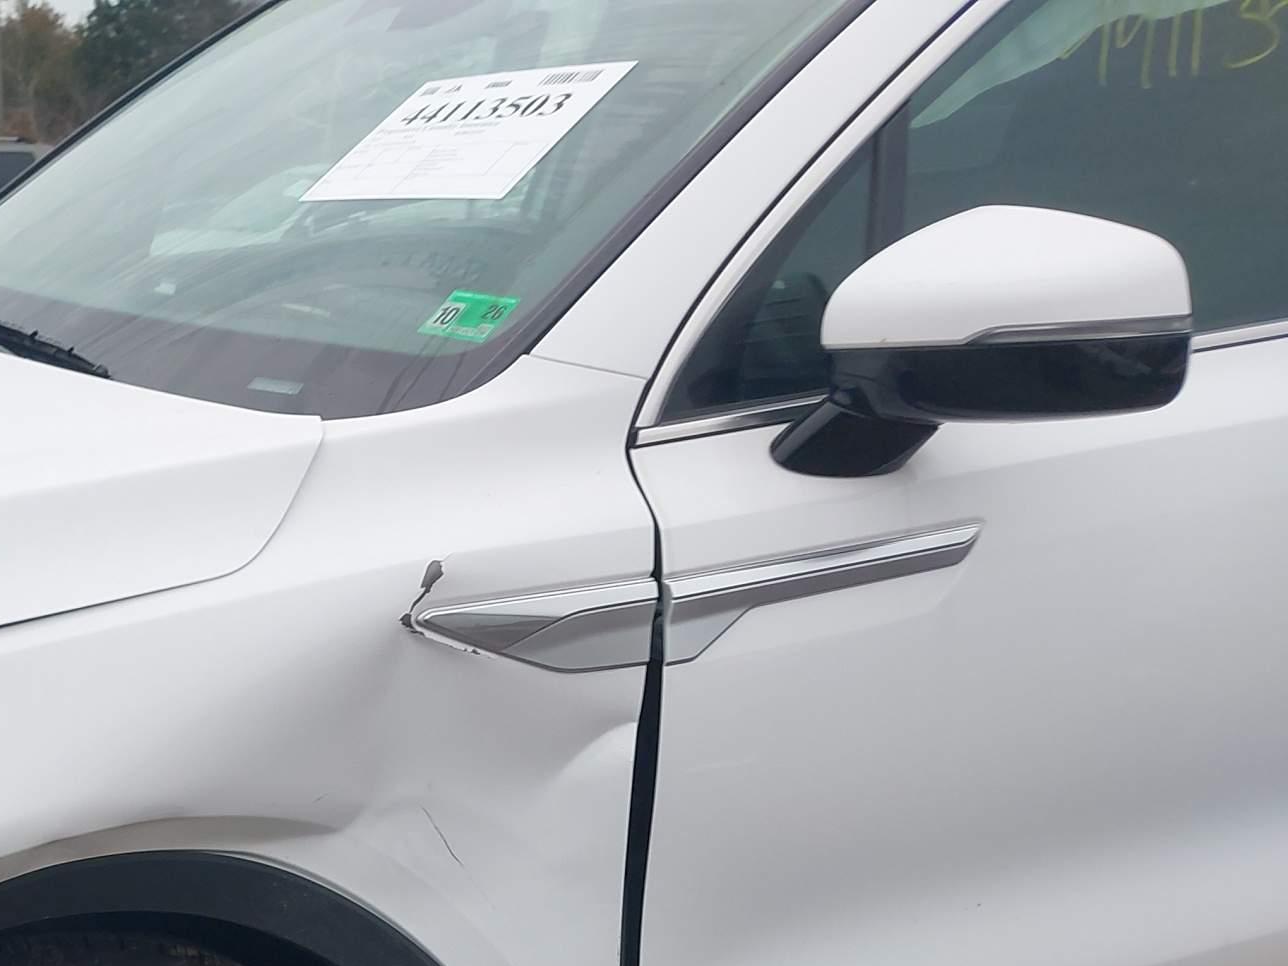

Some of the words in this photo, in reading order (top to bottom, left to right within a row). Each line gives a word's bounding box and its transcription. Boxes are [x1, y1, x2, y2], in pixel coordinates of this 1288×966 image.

[401, 92, 573, 126] 44113503
[433, 305, 460, 325] 10
[481, 304, 507, 321] 26
